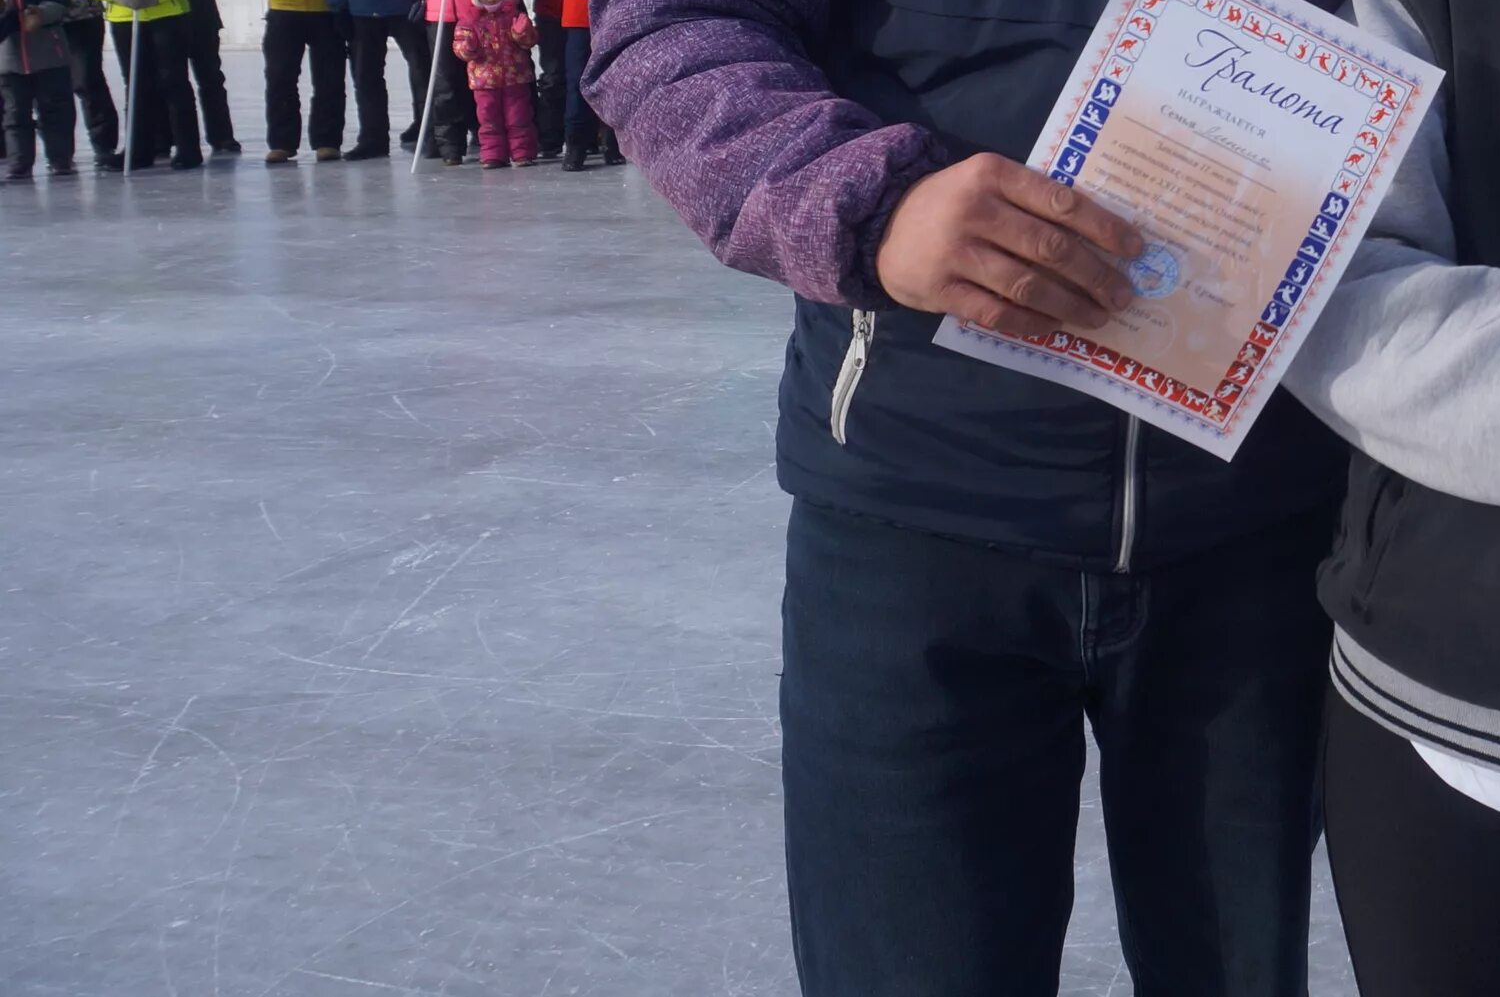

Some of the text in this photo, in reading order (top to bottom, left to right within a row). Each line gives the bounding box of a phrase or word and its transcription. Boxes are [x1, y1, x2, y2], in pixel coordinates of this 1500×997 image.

[1184, 29, 1345, 135] Грамота
[1157, 102, 1199, 130] Семья
[1175, 87, 1268, 138] НАГРАЖДАЕТСЯ
